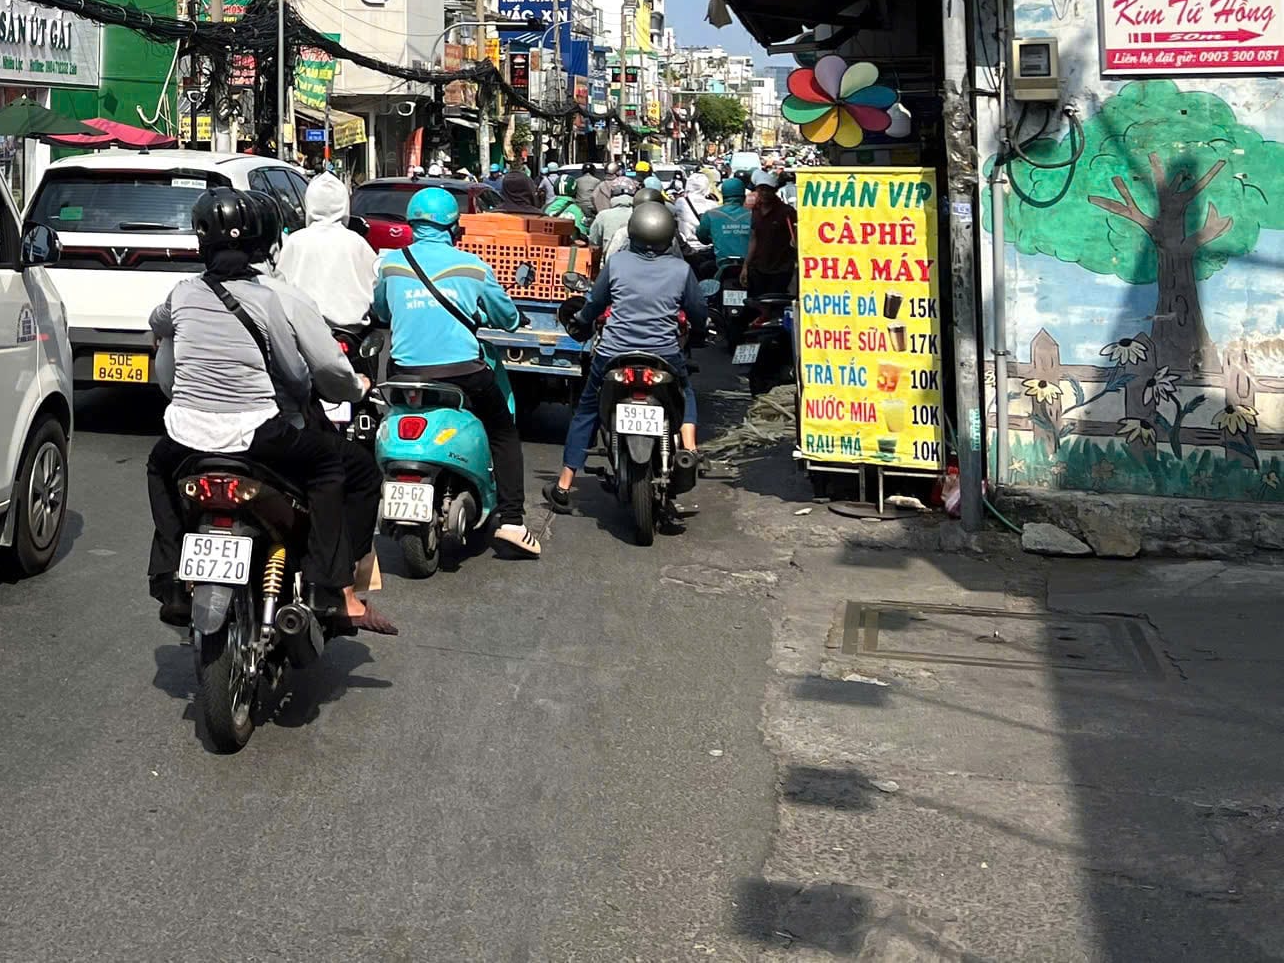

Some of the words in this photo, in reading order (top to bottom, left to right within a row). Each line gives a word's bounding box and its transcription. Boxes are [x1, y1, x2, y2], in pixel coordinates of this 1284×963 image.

[541, 7, 568, 23] XN
[29, 6, 47, 47] ÚT
[50, 10, 73, 51] GÁI
[1167, 32, 1226, 41] 50m
[1112, 52, 1138, 64] Liên
[1140, 53, 1154, 65] hệ
[1155, 51, 1175, 64] đặt
[1176, 51, 1197, 67] giờ:
[1199, 50, 1229, 62] 0903
[1232, 50, 1255, 62] 300
[1257, 49, 1279, 61] 081
[802, 173, 879, 208] NHÂN
[888, 181, 933, 209] VIP
[818, 215, 917, 246] CÀPHÊ
[802, 256, 862, 281] PHA
[870, 252, 935, 283] MÁY
[803, 288, 852, 315] CÀPHÊ
[857, 291, 877, 317] ĐÁ
[909, 297, 938, 318] 15K
[804, 324, 852, 350] CÀPHÊ
[858, 326, 887, 352] SỮA
[910, 333, 938, 354] 17K
[109, 353, 133, 366] 50E
[99, 367, 143, 380] 849.48
[805, 359, 834, 384] TRÀ
[838, 357, 868, 387] TẮC
[910, 369, 939, 390] 10K
[623, 406, 657, 420] 59-L2
[805, 395, 845, 421] NƯỚC
[850, 397, 877, 423] MÍA
[911, 404, 940, 426] 10K
[806, 434, 835, 454] RAU
[840, 431, 863, 456] MÁ
[912, 440, 941, 462] 10K
[391, 485, 425, 502] 29-G2
[387, 502, 429, 519] 177.43
[193, 538, 240, 558] 59-E1
[184, 557, 245, 579] 667.20
